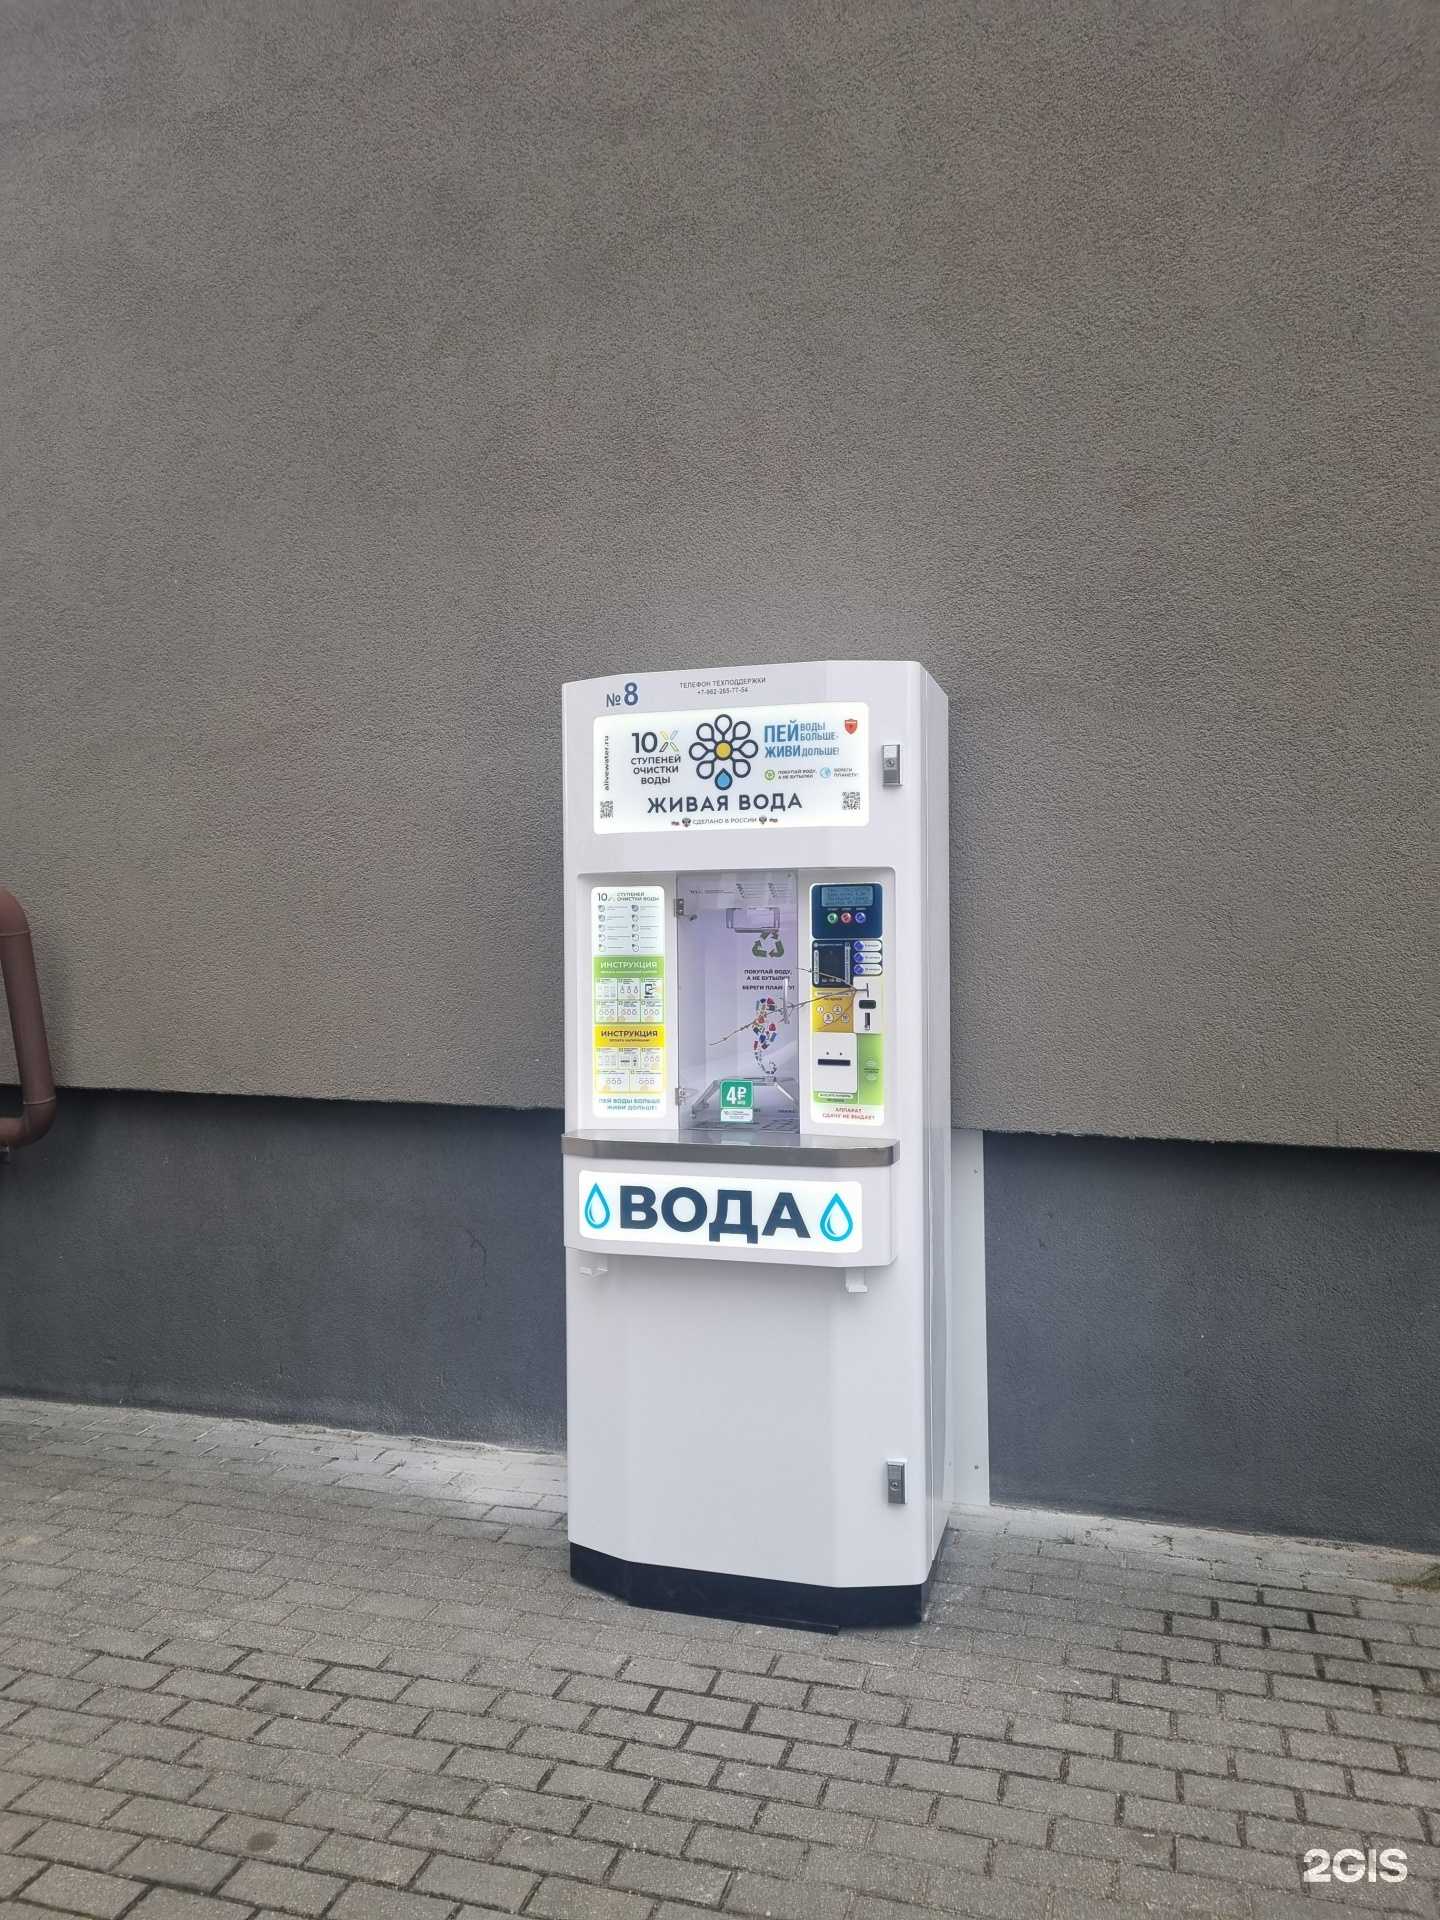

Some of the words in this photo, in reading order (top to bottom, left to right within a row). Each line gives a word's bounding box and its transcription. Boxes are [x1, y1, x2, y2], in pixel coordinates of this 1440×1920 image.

[712, 676, 766, 687] ТЕХПОДДЕРЖКИ
[606, 692, 621, 707] №
[624, 682, 639, 706] 8
[764, 719, 799, 743] ПЕЙ
[800, 722, 826, 732] ВОДЫ
[765, 745, 800, 758] ЖИВИ
[630, 754, 681, 765] СТУПЕНЕЙ
[633, 765, 679, 775] ОЧИСТКИ
[641, 776, 671, 785] ВОДЫ
[647, 795, 729, 814] ЖИВАЯ
[738, 792, 803, 812] ВОДА
[600, 961, 658, 969] ИНСТРУКЦИЯ
[601, 1030, 658, 1038] ИНСТРУКЦИЯ
[619, 1184, 811, 1244] ВОДА
